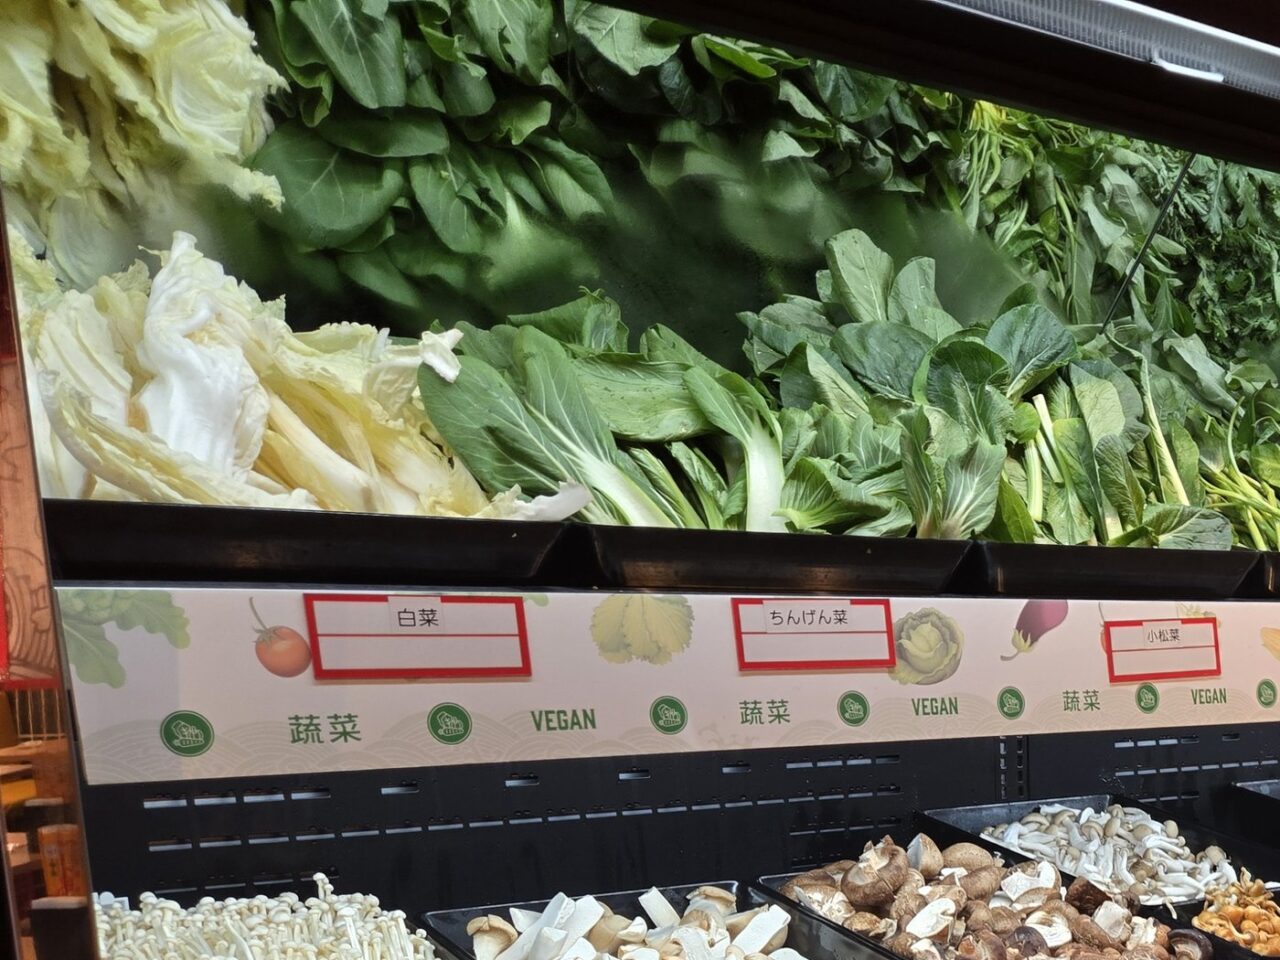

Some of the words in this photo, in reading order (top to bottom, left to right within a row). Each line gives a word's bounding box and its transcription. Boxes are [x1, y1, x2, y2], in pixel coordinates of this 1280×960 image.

[398, 608, 439, 628] 白菜
[770, 609, 849, 626] ちんげん菜
[1147, 628, 1180, 643] 小松菜
[1062, 689, 1100, 711] 蔬菜
[1191, 688, 1227, 705] VEGAN
[739, 700, 791, 724] 蔬菜
[911, 697, 958, 717] VEGAN
[288, 713, 361, 744] 蔬菜
[531, 709, 597, 732] VEGAN
